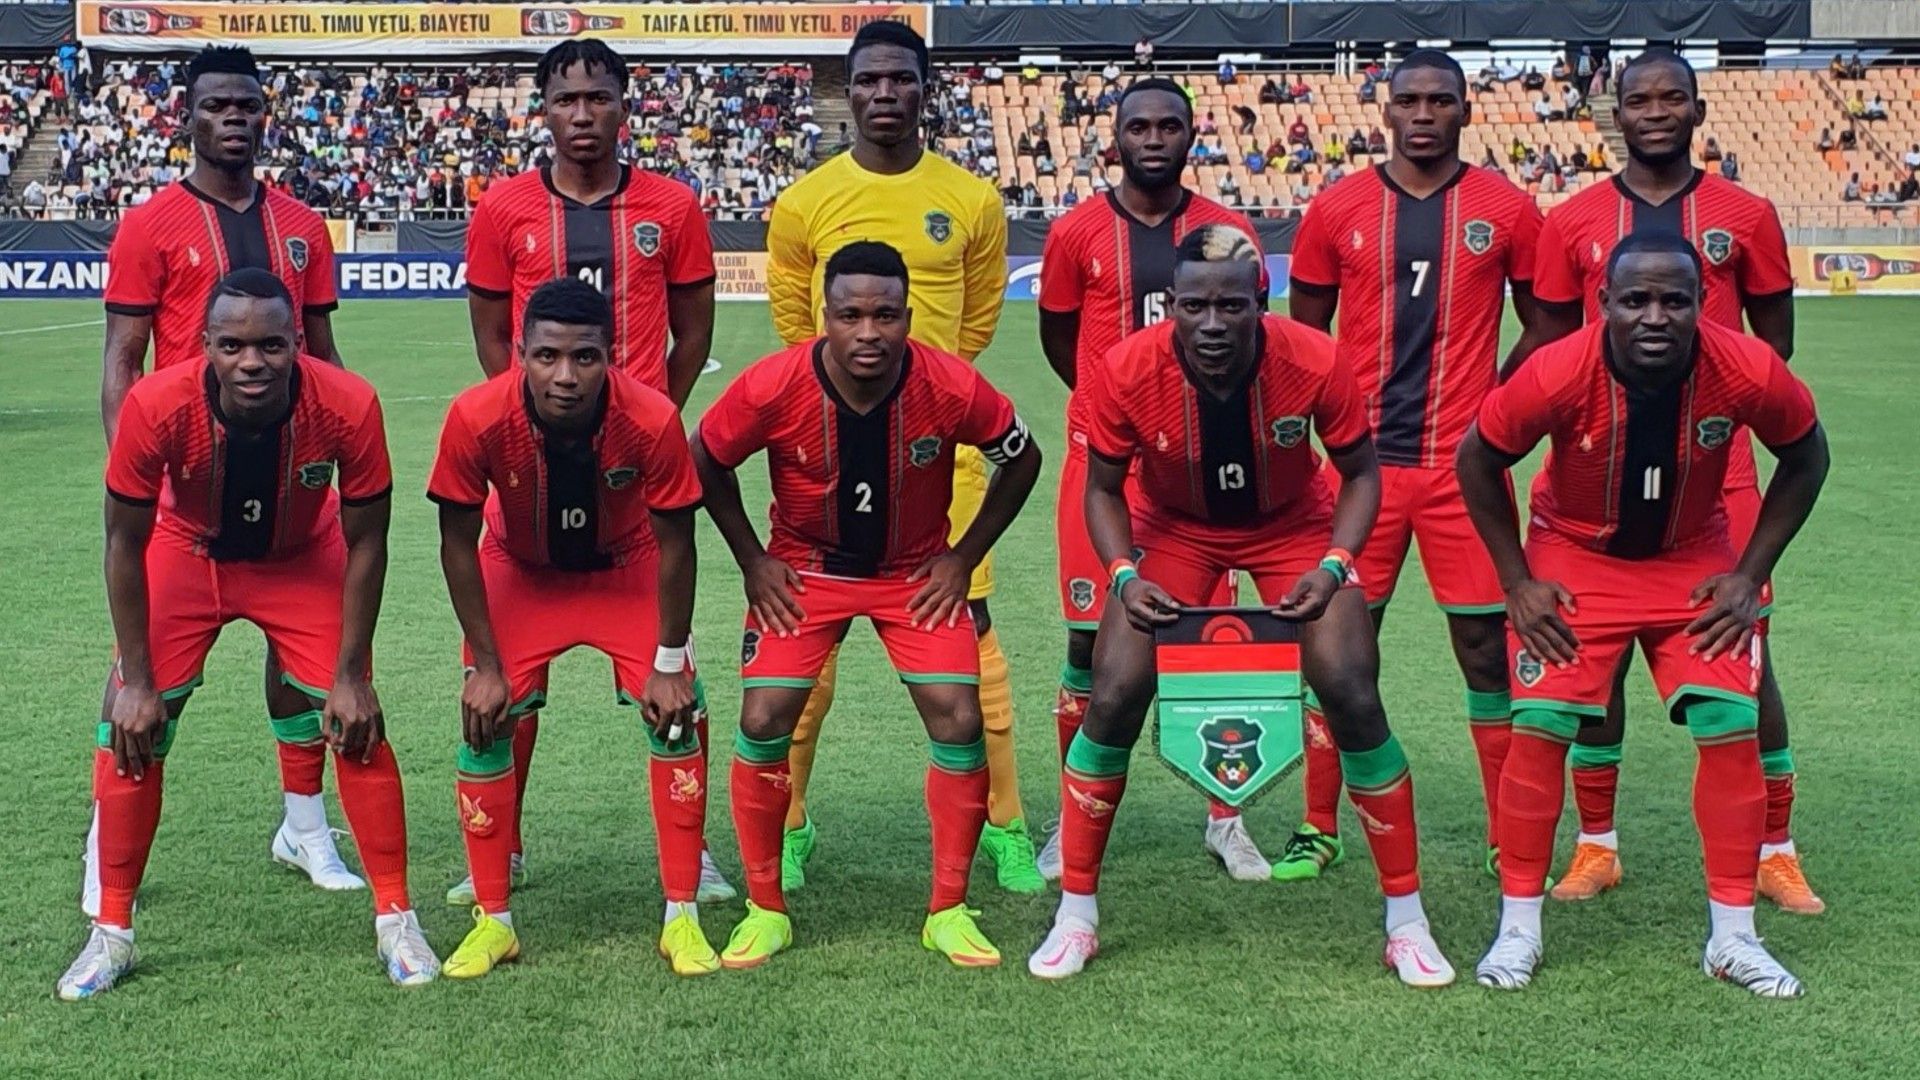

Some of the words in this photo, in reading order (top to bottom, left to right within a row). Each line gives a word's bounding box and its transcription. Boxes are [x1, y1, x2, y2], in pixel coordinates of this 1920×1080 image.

[219, 14, 267, 33] TAIFA
[271, 14, 316, 33] LETU.
[321, 14, 364, 33] TIMU
[368, 14, 415, 33] YETU.
[420, 14, 490, 33] BIAYETU
[642, 14, 690, 33] TAIFA
[694, 14, 738, 33] LETU.
[743, 14, 785, 33] TIMU
[790, 14, 836, 33] YETU.
[738, 269, 756, 280] WA
[1411, 261, 1430, 297] 7
[735, 282, 768, 294] STARS
[1143, 292, 1165, 328] 15
[1218, 463, 1245, 490] 13
[1643, 465, 1661, 500] 11
[855, 481, 872, 513] 2
[243, 499, 262, 522] 3
[562, 507, 587, 530] 10
